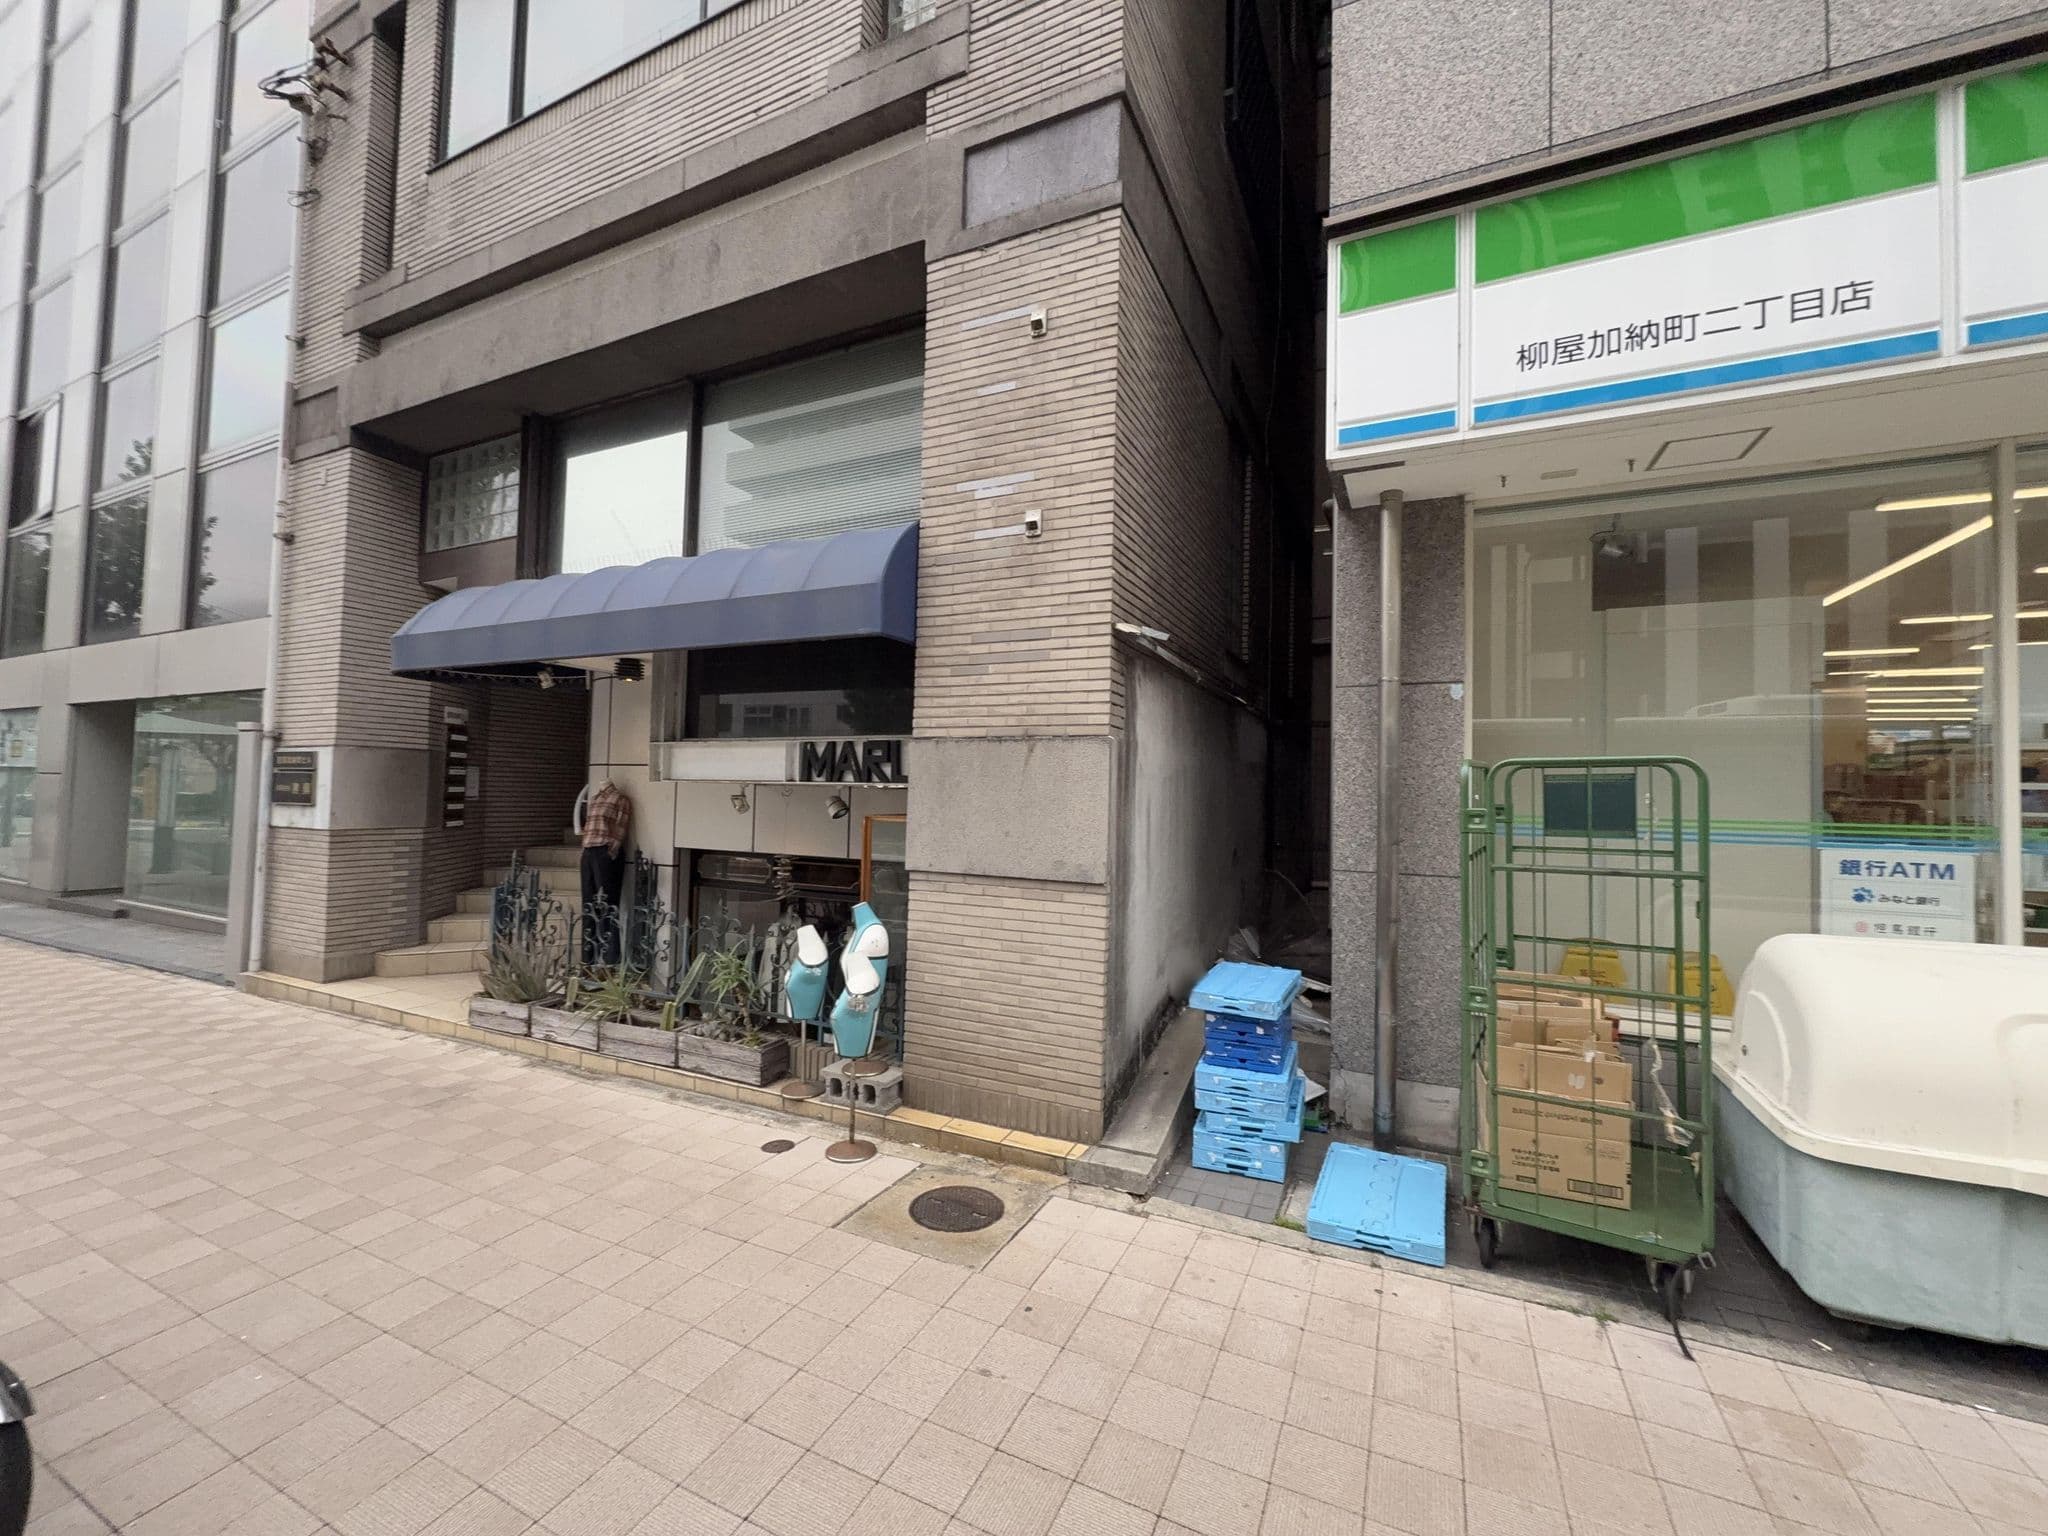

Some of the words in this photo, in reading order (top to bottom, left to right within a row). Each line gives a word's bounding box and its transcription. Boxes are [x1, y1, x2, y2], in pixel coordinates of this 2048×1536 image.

[1515, 280, 1874, 372] 柳屋加納町二丁目店
[1838, 859, 1955, 881] 銀行ATM
[1877, 894, 1940, 906] みなと銀行
